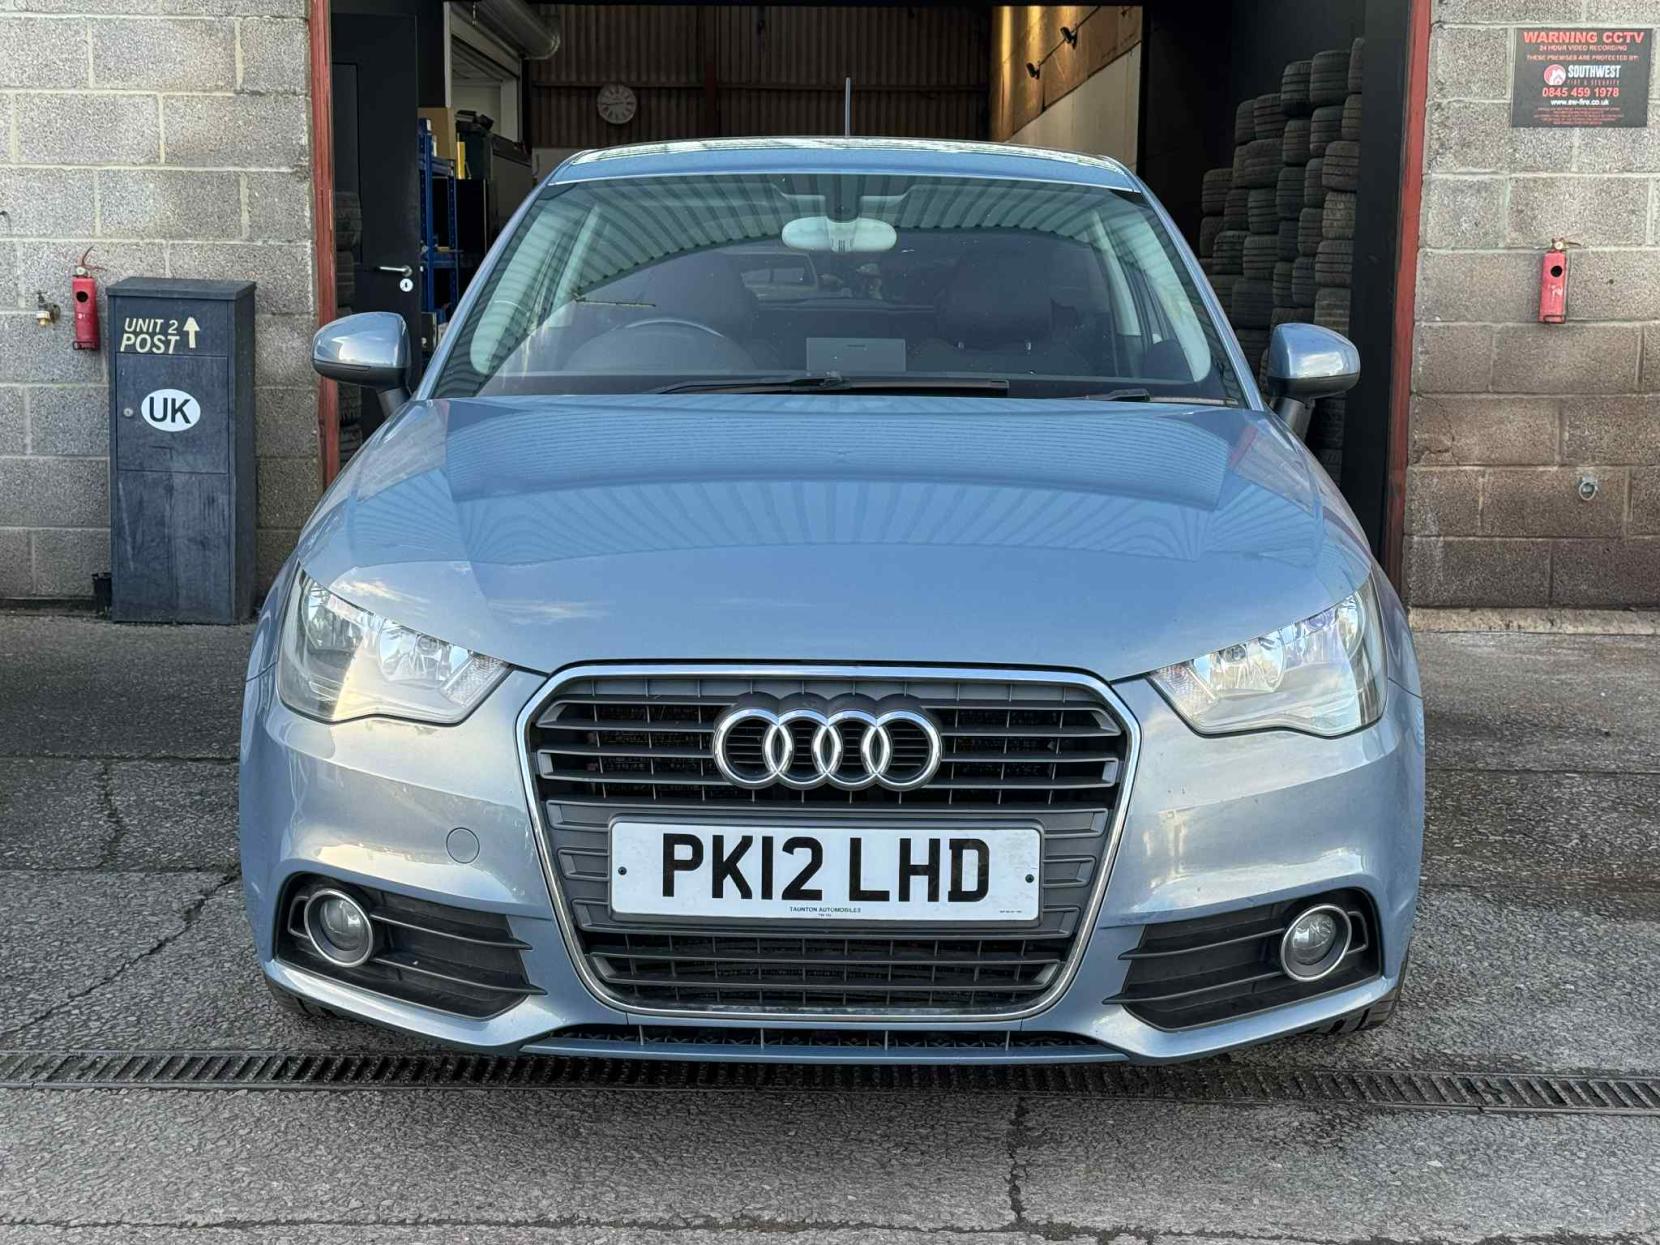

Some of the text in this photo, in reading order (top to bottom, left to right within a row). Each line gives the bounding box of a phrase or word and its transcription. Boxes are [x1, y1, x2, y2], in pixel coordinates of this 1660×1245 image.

[1523, 31, 1644, 43] WARNING CCTV
[1567, 65, 1621, 78] SOUTHWEST
[1542, 87, 1620, 97] 0845 459 1978
[124, 317, 179, 334] UNIT 2
[120, 334, 181, 354] POST
[150, 396, 192, 424] UK
[661, 832, 990, 903] PK12 LHD
